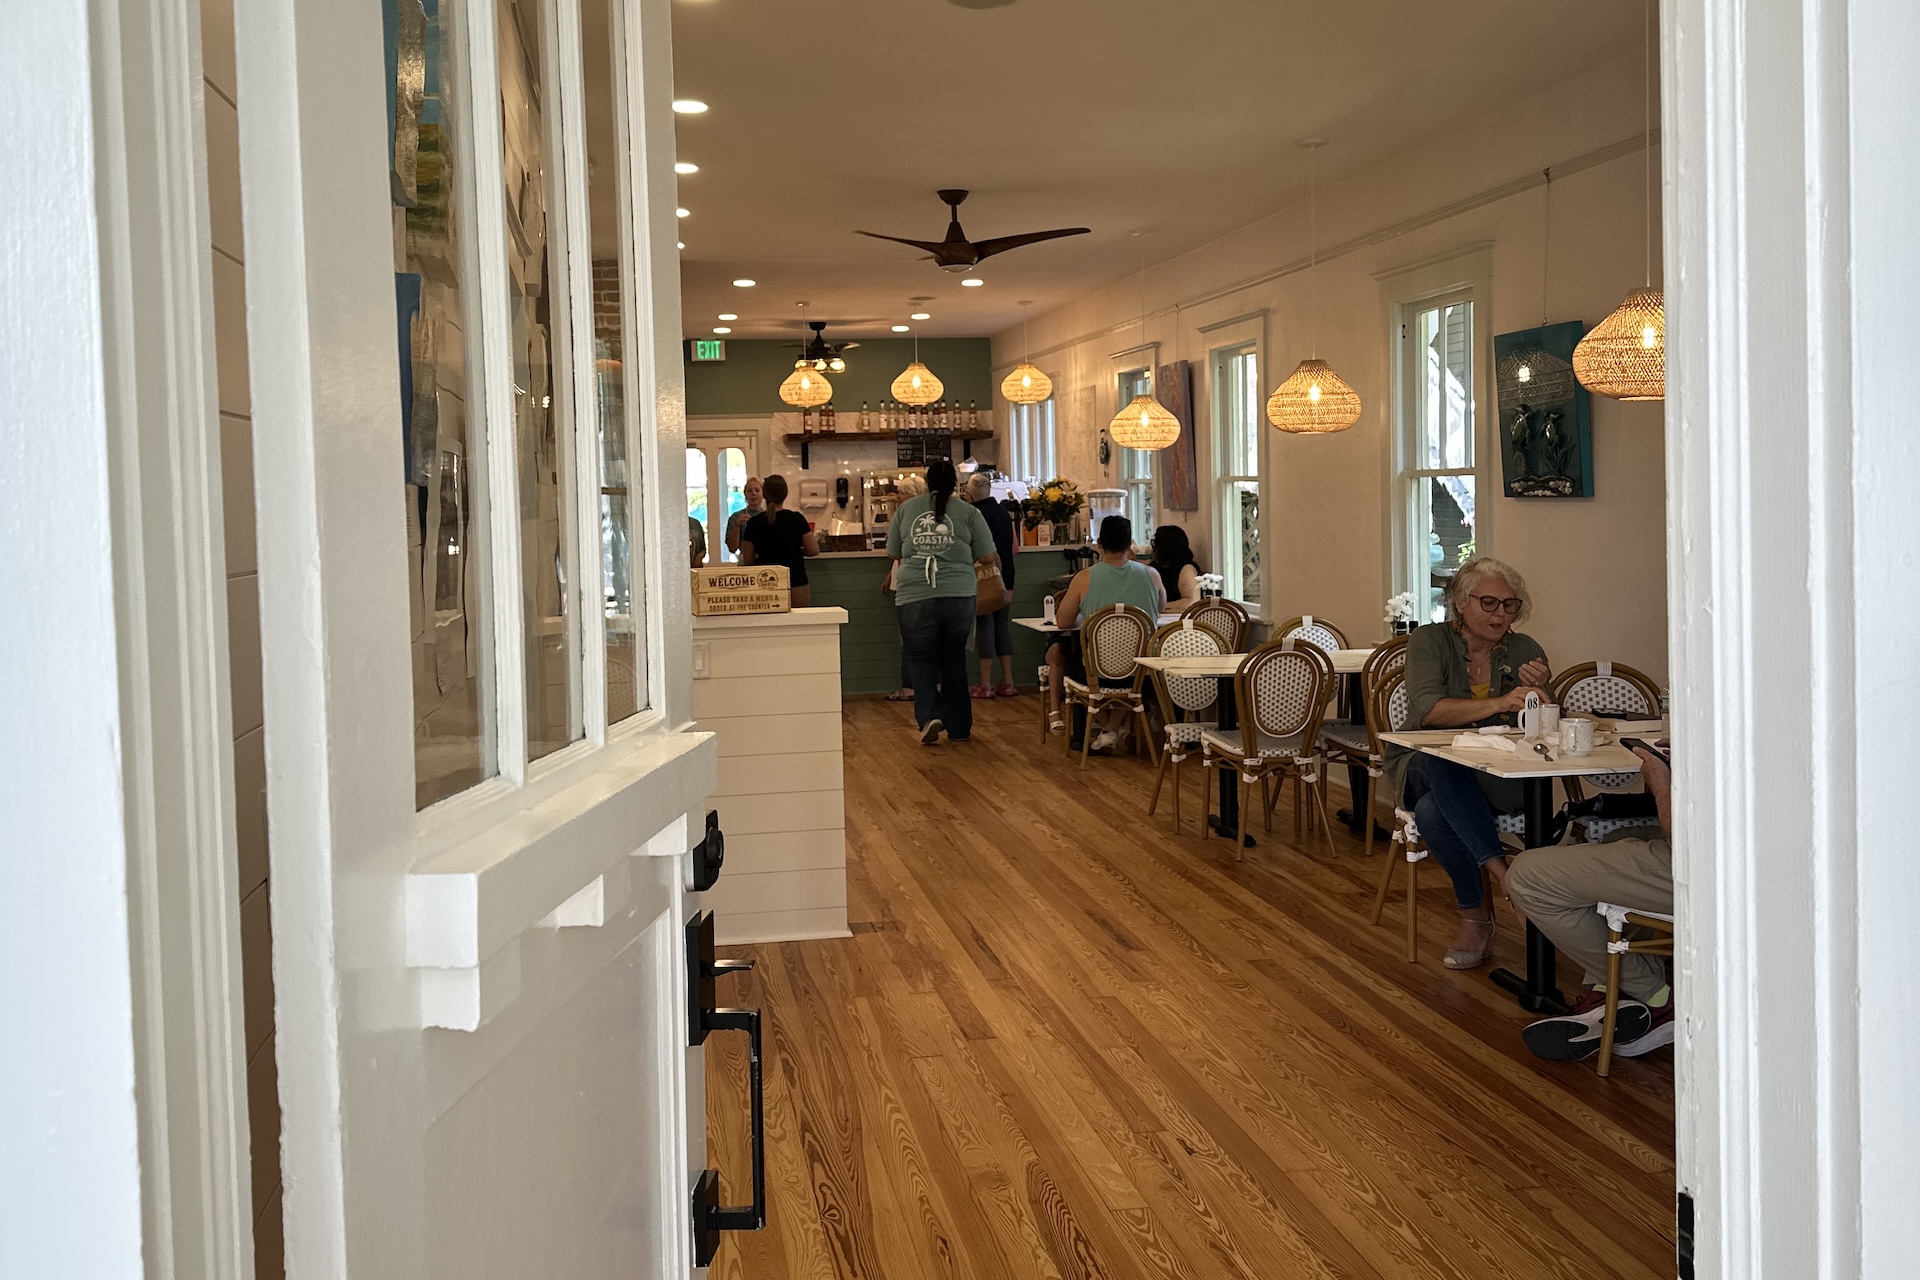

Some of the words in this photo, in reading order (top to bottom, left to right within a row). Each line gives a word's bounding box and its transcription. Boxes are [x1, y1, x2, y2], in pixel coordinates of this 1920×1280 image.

[696, 340, 721, 359] EXIT
[912, 535, 955, 545] COASTAL
[708, 576, 756, 587] WELCOME
[707, 596, 731, 604] PLEASE
[732, 595, 748, 603] TAKE
[755, 594, 774, 602] MENU
[748, 603, 771, 611] COUNTER
[1527, 697, 1538, 709] 08
